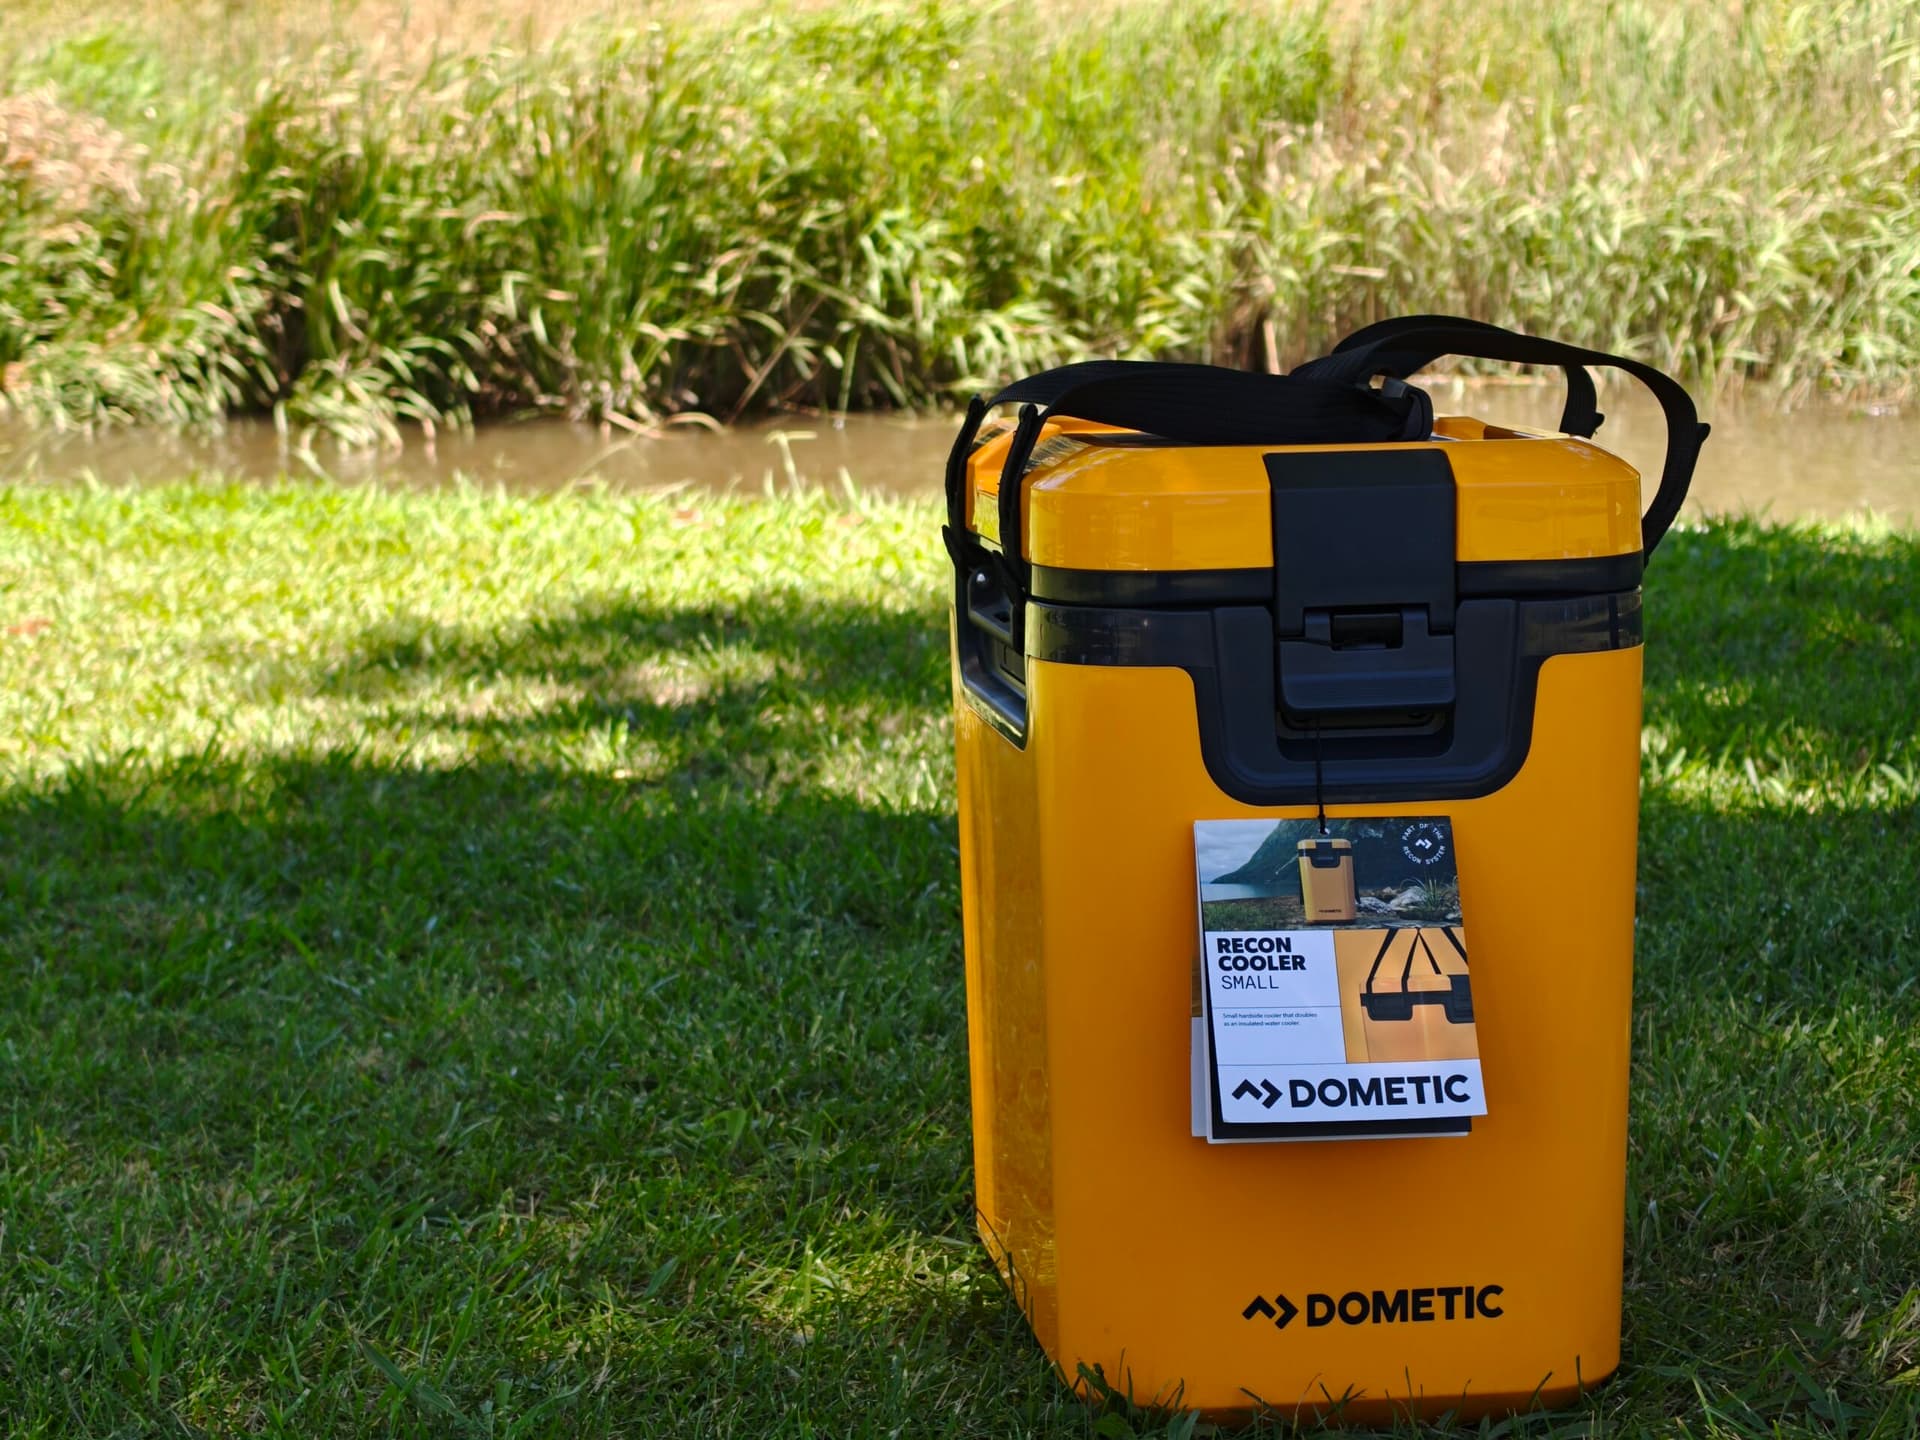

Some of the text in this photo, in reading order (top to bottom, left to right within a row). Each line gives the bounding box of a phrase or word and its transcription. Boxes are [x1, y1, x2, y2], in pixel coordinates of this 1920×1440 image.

[1217, 937, 1292, 954] RECON
[1218, 955, 1306, 971] COOLER
[1221, 975, 1279, 990] SMALL
[1289, 1074, 1471, 1108] DOMETIC
[1306, 1284, 1505, 1327] DOMETIC
